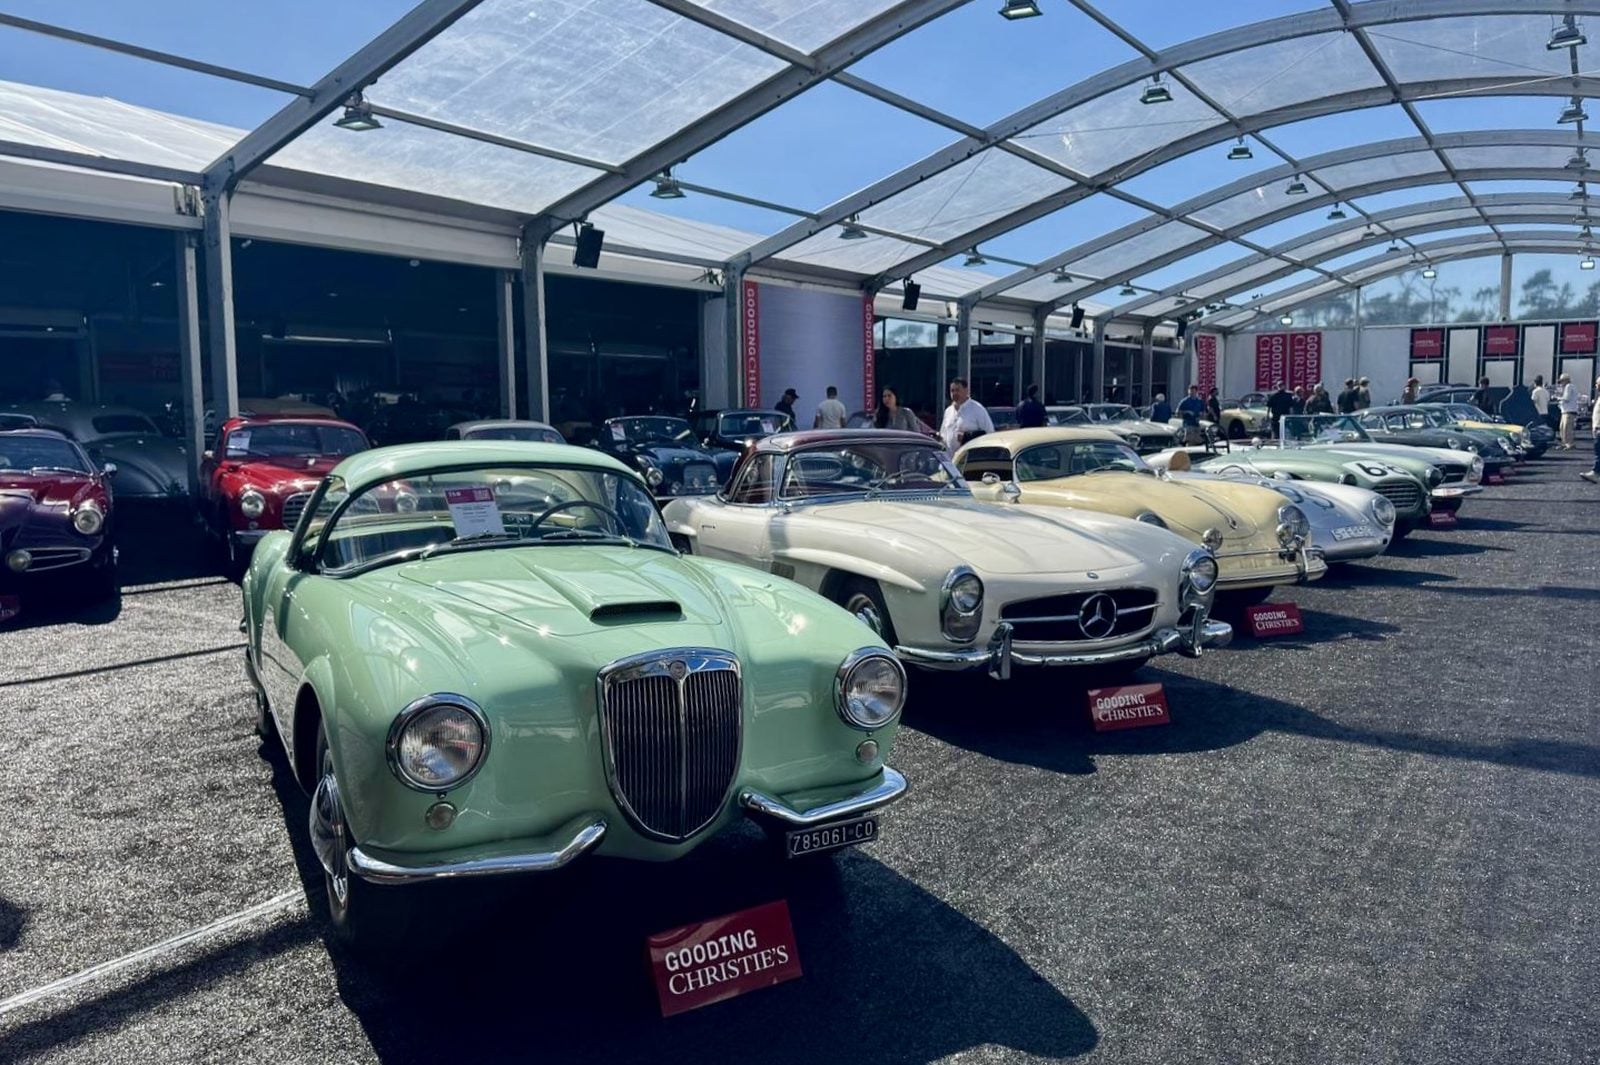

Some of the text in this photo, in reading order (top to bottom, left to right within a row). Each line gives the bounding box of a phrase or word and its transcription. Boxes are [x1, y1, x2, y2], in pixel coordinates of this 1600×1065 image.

[747, 288, 757, 355] GOODING
[1253, 610, 1287, 621] GOODING
[1096, 692, 1146, 710] GOODING
[1098, 703, 1164, 722] CHRISTIE'S
[793, 826, 846, 852] 785061
[665, 928, 758, 972] GOODING
[668, 945, 789, 995] CHRISTIE'S
